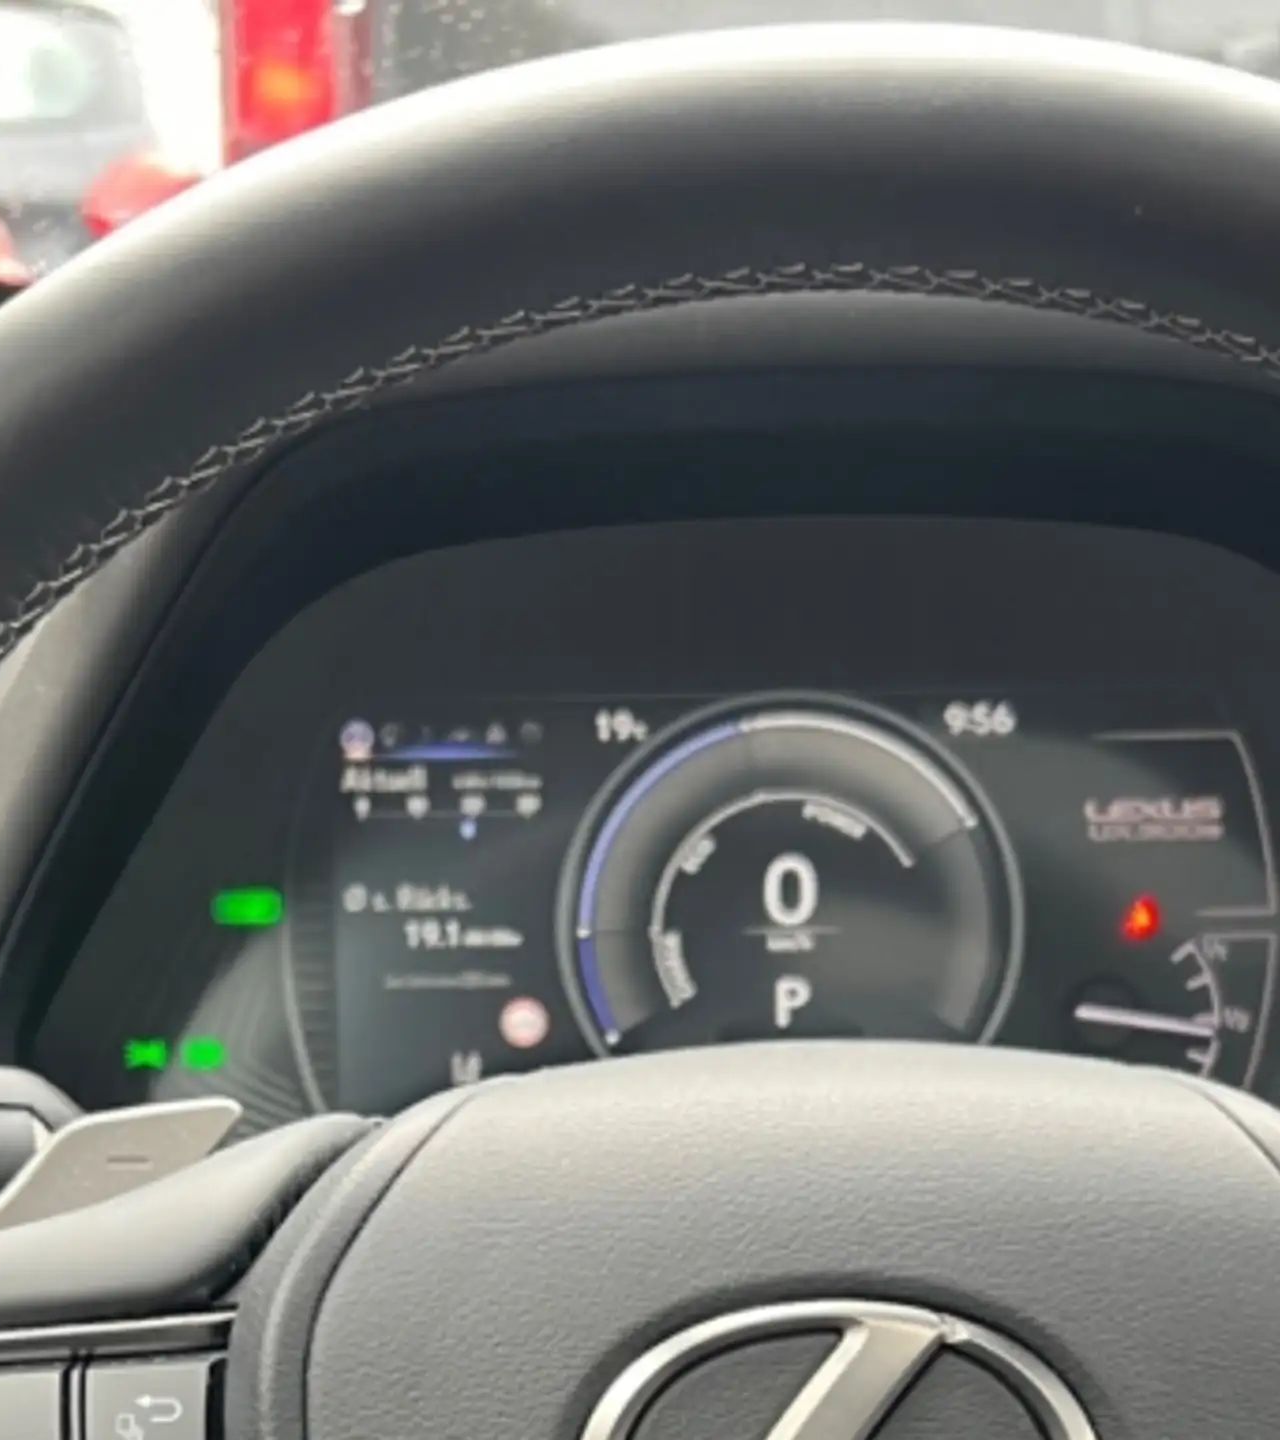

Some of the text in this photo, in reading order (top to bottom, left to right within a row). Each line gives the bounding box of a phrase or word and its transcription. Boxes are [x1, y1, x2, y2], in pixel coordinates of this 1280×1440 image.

[1083, 796, 1224, 821] LEXUS
[762, 852, 819, 927] 0
[774, 974, 812, 1030] P
